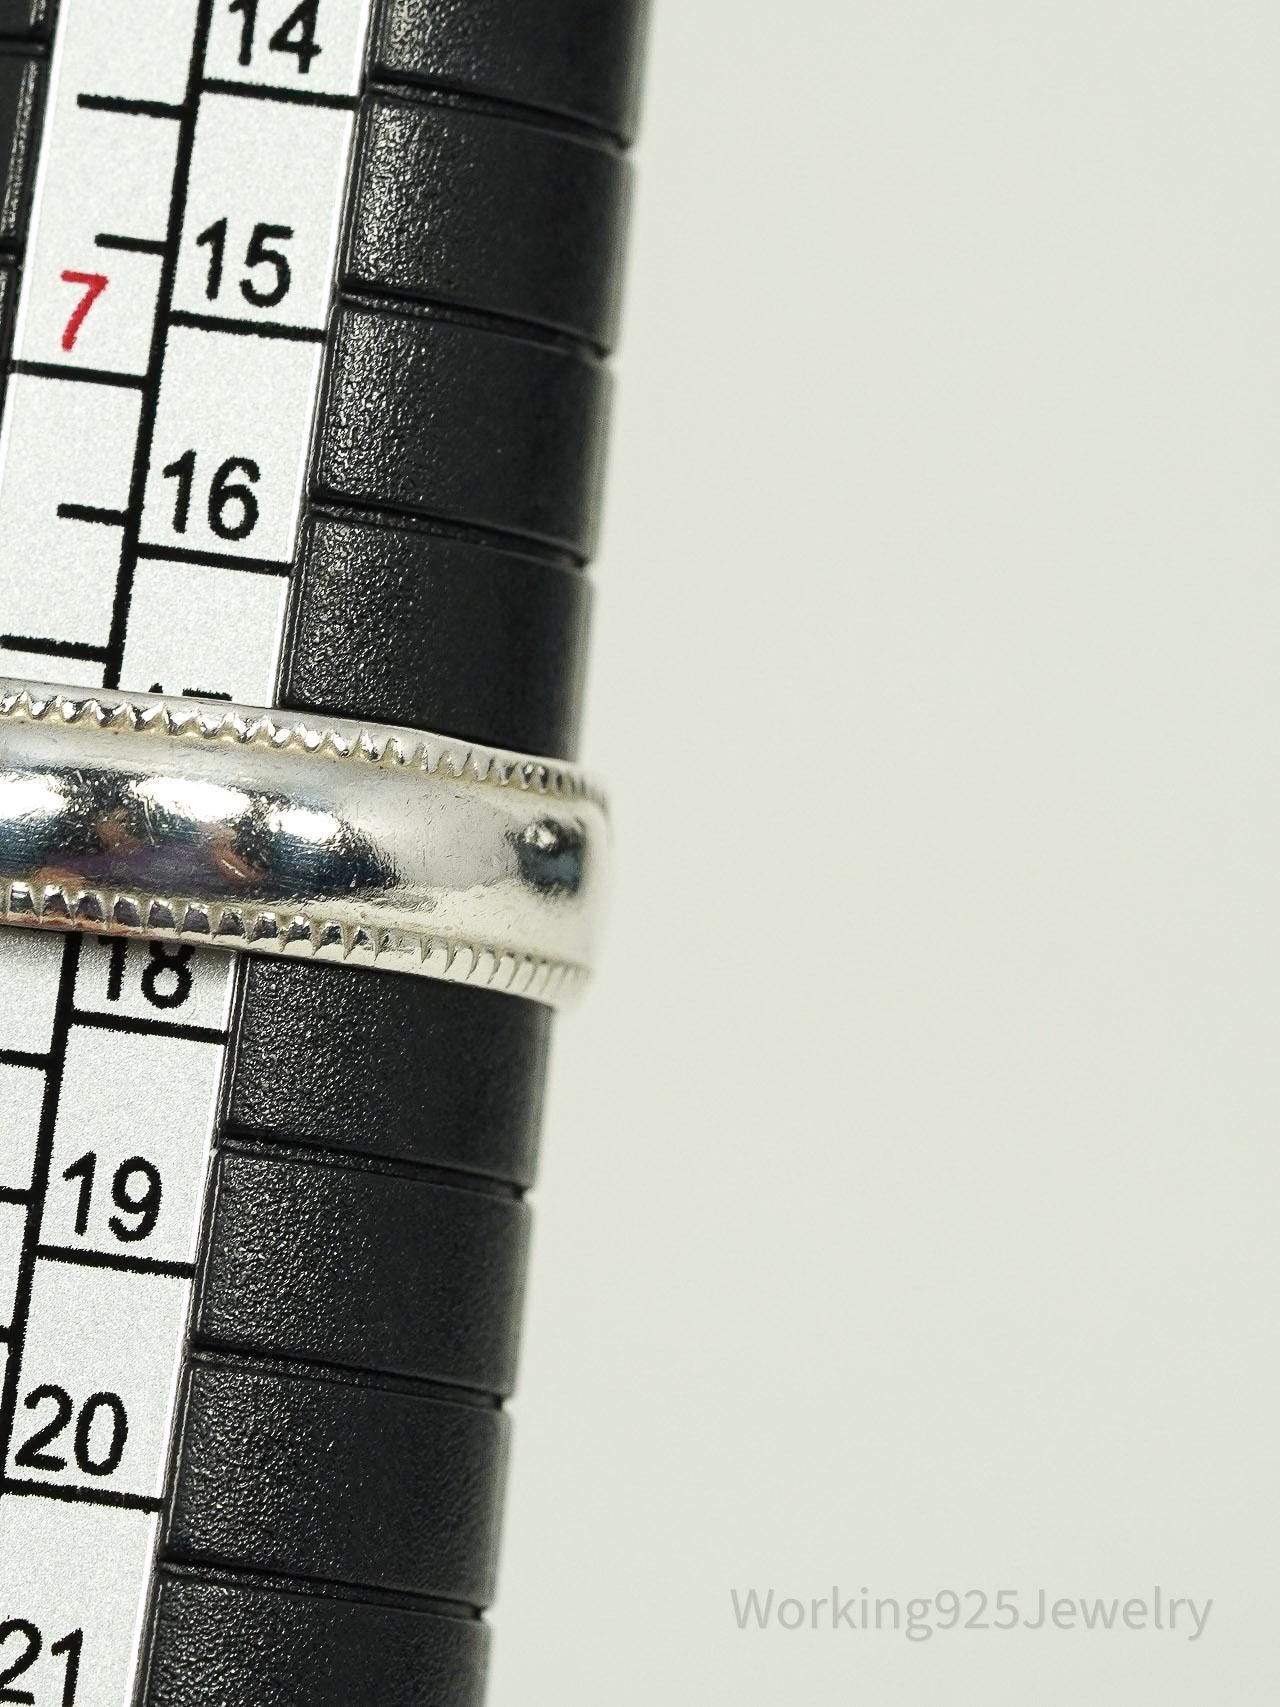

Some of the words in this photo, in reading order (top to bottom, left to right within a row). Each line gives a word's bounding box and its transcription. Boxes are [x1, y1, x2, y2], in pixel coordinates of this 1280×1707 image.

[229, 0, 321, 73] 14
[197, 218, 294, 308] 15
[62, 271, 108, 351] 7
[163, 450, 261, 541] 16
[98, 935, 195, 1009] 18
[62, 1151, 163, 1243] 19
[15, 1384, 128, 1476] 20
